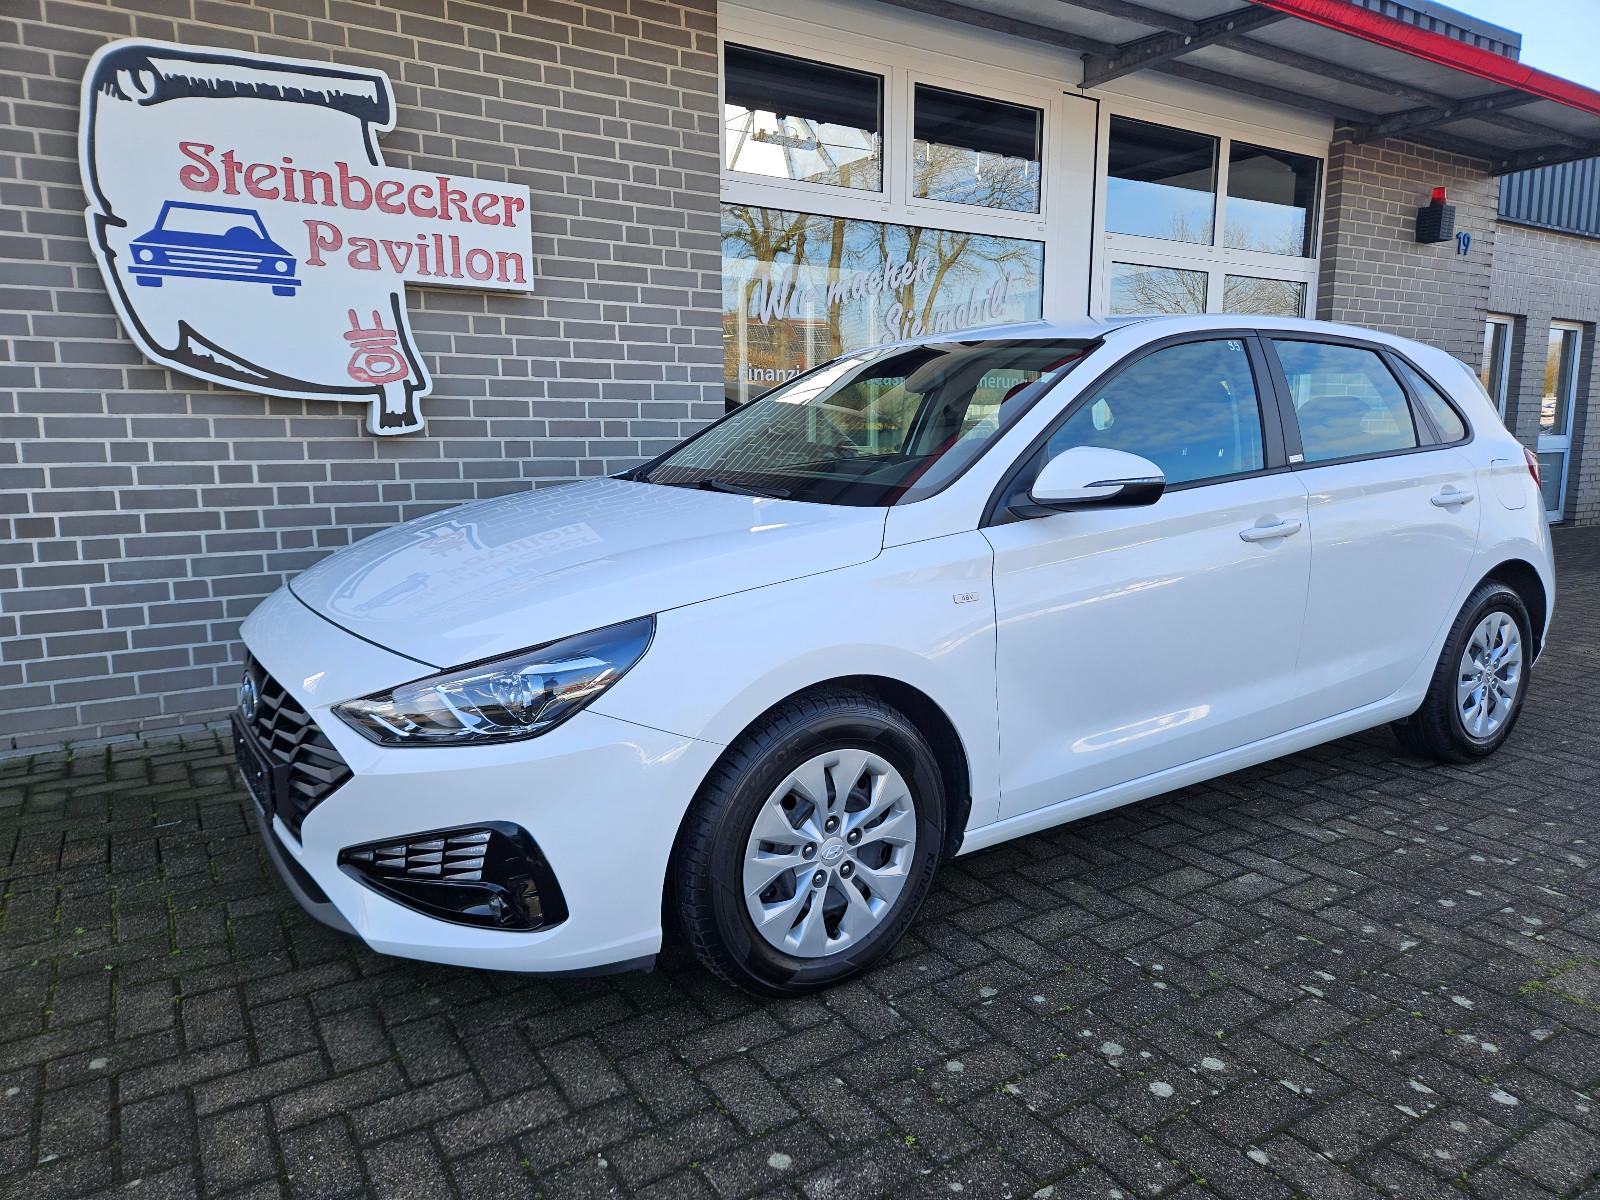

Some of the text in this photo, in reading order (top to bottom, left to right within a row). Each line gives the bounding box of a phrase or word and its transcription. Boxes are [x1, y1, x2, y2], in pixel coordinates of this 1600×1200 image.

[178, 141, 526, 228] Steinbecker
[302, 219, 528, 285] Pavillon
[1455, 231, 1471, 256] 19
[826, 252, 931, 307] machen
[881, 301, 927, 341] Sie
